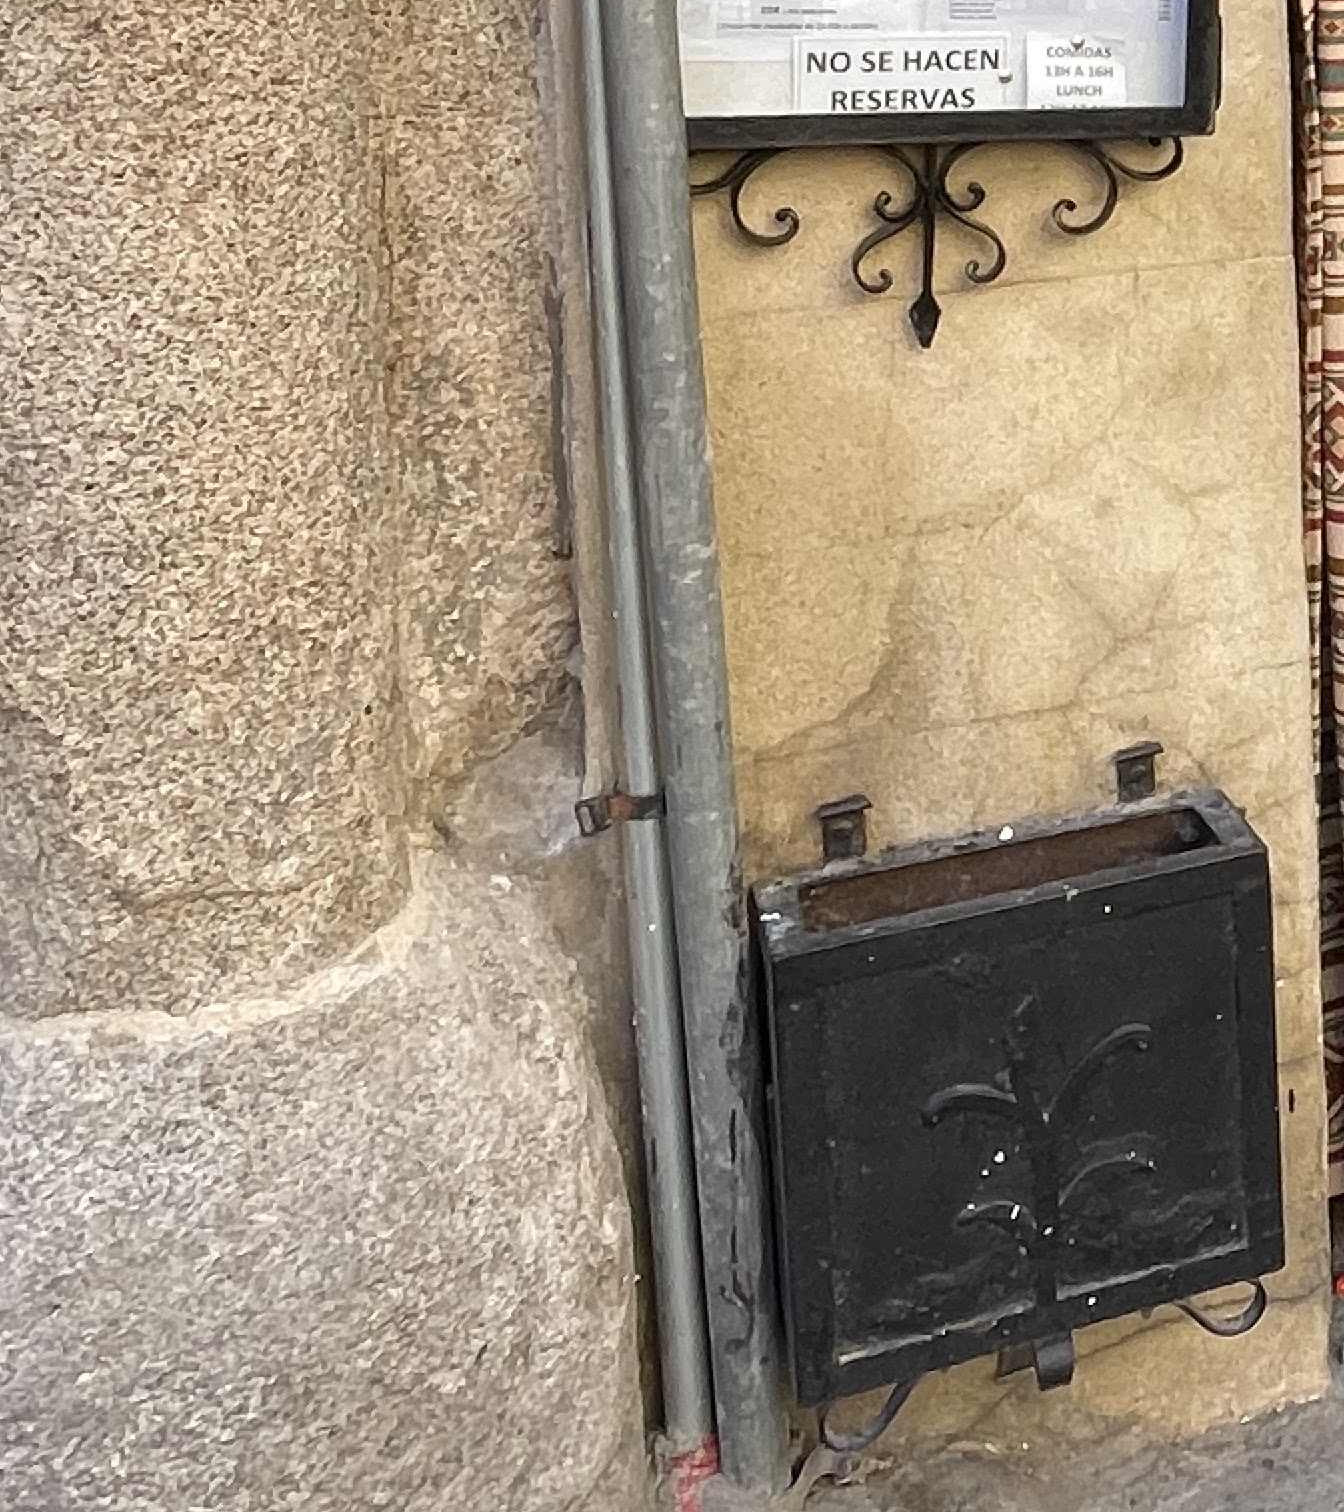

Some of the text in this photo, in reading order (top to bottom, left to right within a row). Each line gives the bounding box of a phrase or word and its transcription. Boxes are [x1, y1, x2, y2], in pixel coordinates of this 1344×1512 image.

[806, 48, 999, 73] NO SE HACEN
[1074, 66, 1084, 78] A
[1088, 65, 1114, 78] 16H
[831, 87, 976, 112] RESERVAS
[1056, 84, 1102, 96] LUNCH
